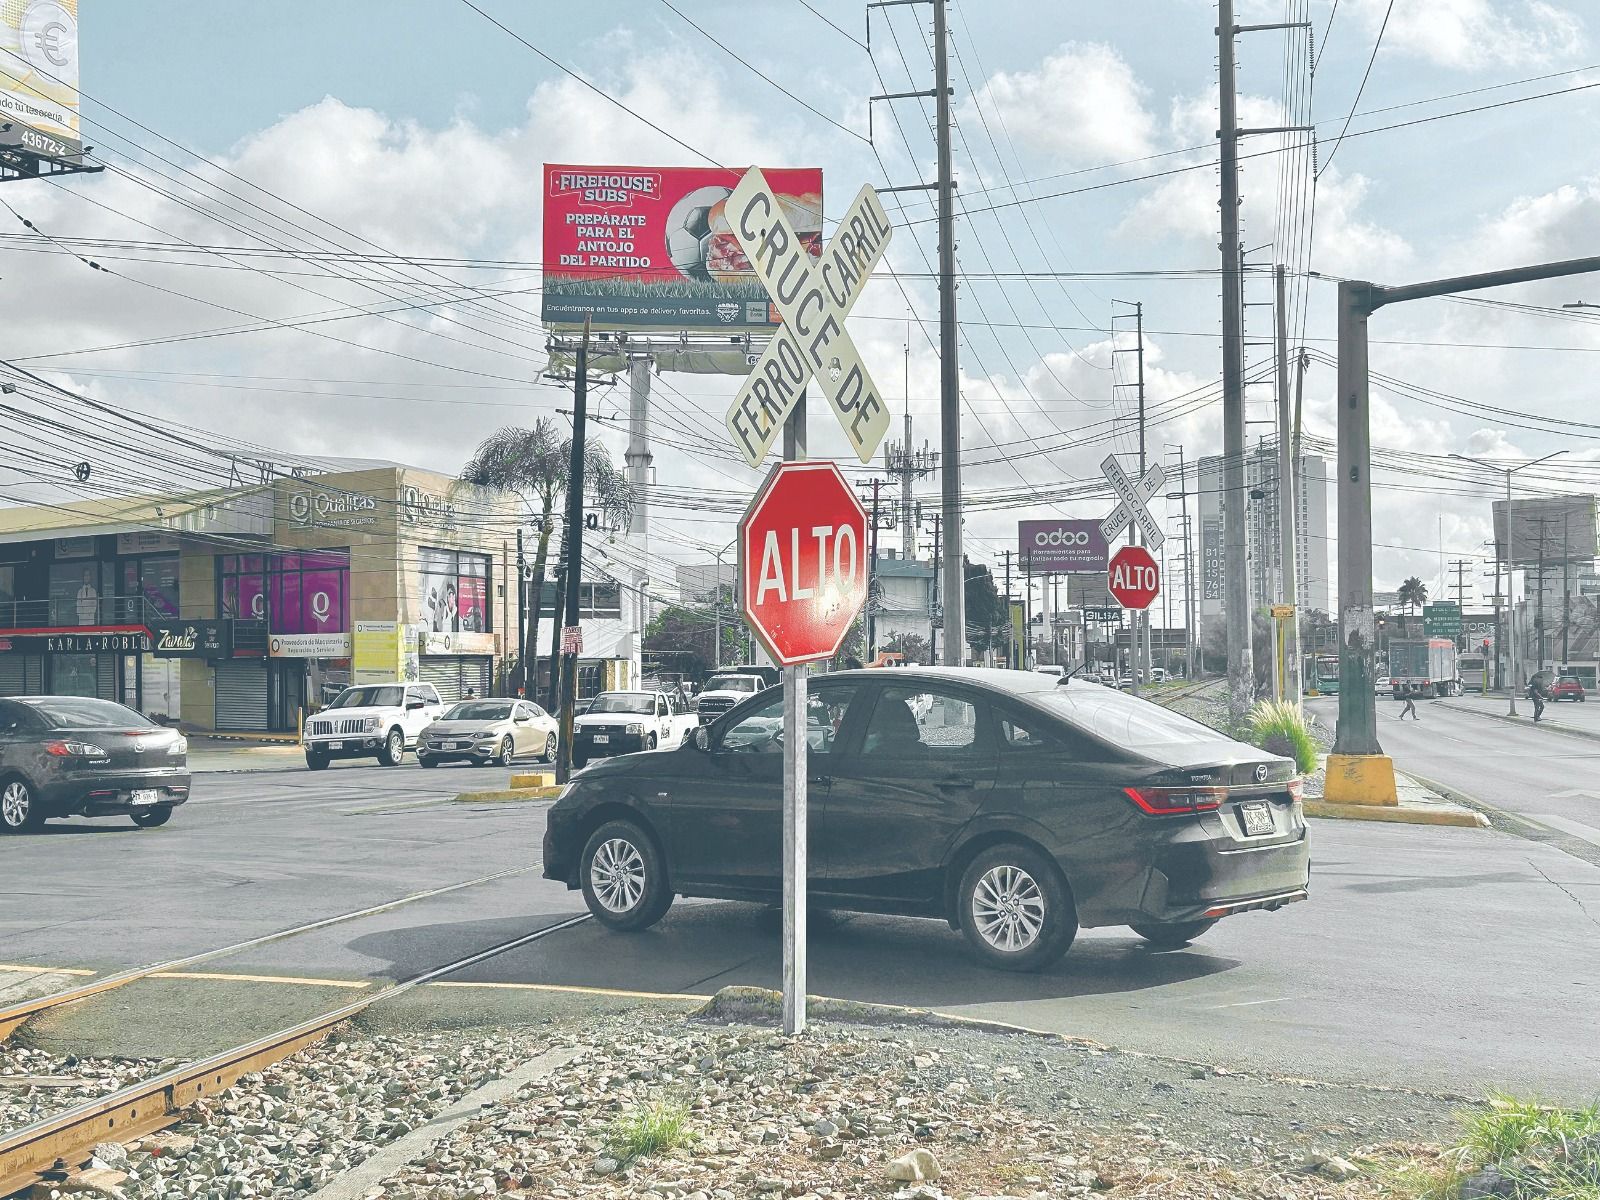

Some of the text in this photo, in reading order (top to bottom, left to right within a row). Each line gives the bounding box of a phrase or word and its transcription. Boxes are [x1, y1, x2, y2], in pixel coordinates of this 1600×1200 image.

[0, 98, 13, 110] do
[15, 103, 24, 112] tu
[21, 130, 66, 157] 43672-2
[560, 174, 653, 192] FIREHOUSE
[584, 189, 628, 202] SUBS
[566, 212, 647, 226] PREPÁRATE
[577, 227, 635, 239] PARA EL
[577, 241, 634, 253] ANTOJO
[560, 255, 651, 268] DEL PARTIDO
[607, 306, 619, 314] tus
[620, 307, 638, 316] apps
[639, 307, 648, 315] de
[651, 307, 678, 317] delivery
[740, 192, 881, 446] CRUCE DE
[732, 196, 890, 459] FERRO CARRIL
[1103, 477, 1155, 537] CRUCE DE
[1035, 528, 1089, 546] odoo
[756, 523, 857, 606] ALTO
[1205, 560, 1218, 568] 10
[1113, 565, 1156, 591] ALTO
[1205, 580, 1219, 589] 76
[1205, 590, 1219, 599] 54
[48, 637, 93, 651] KARLA
